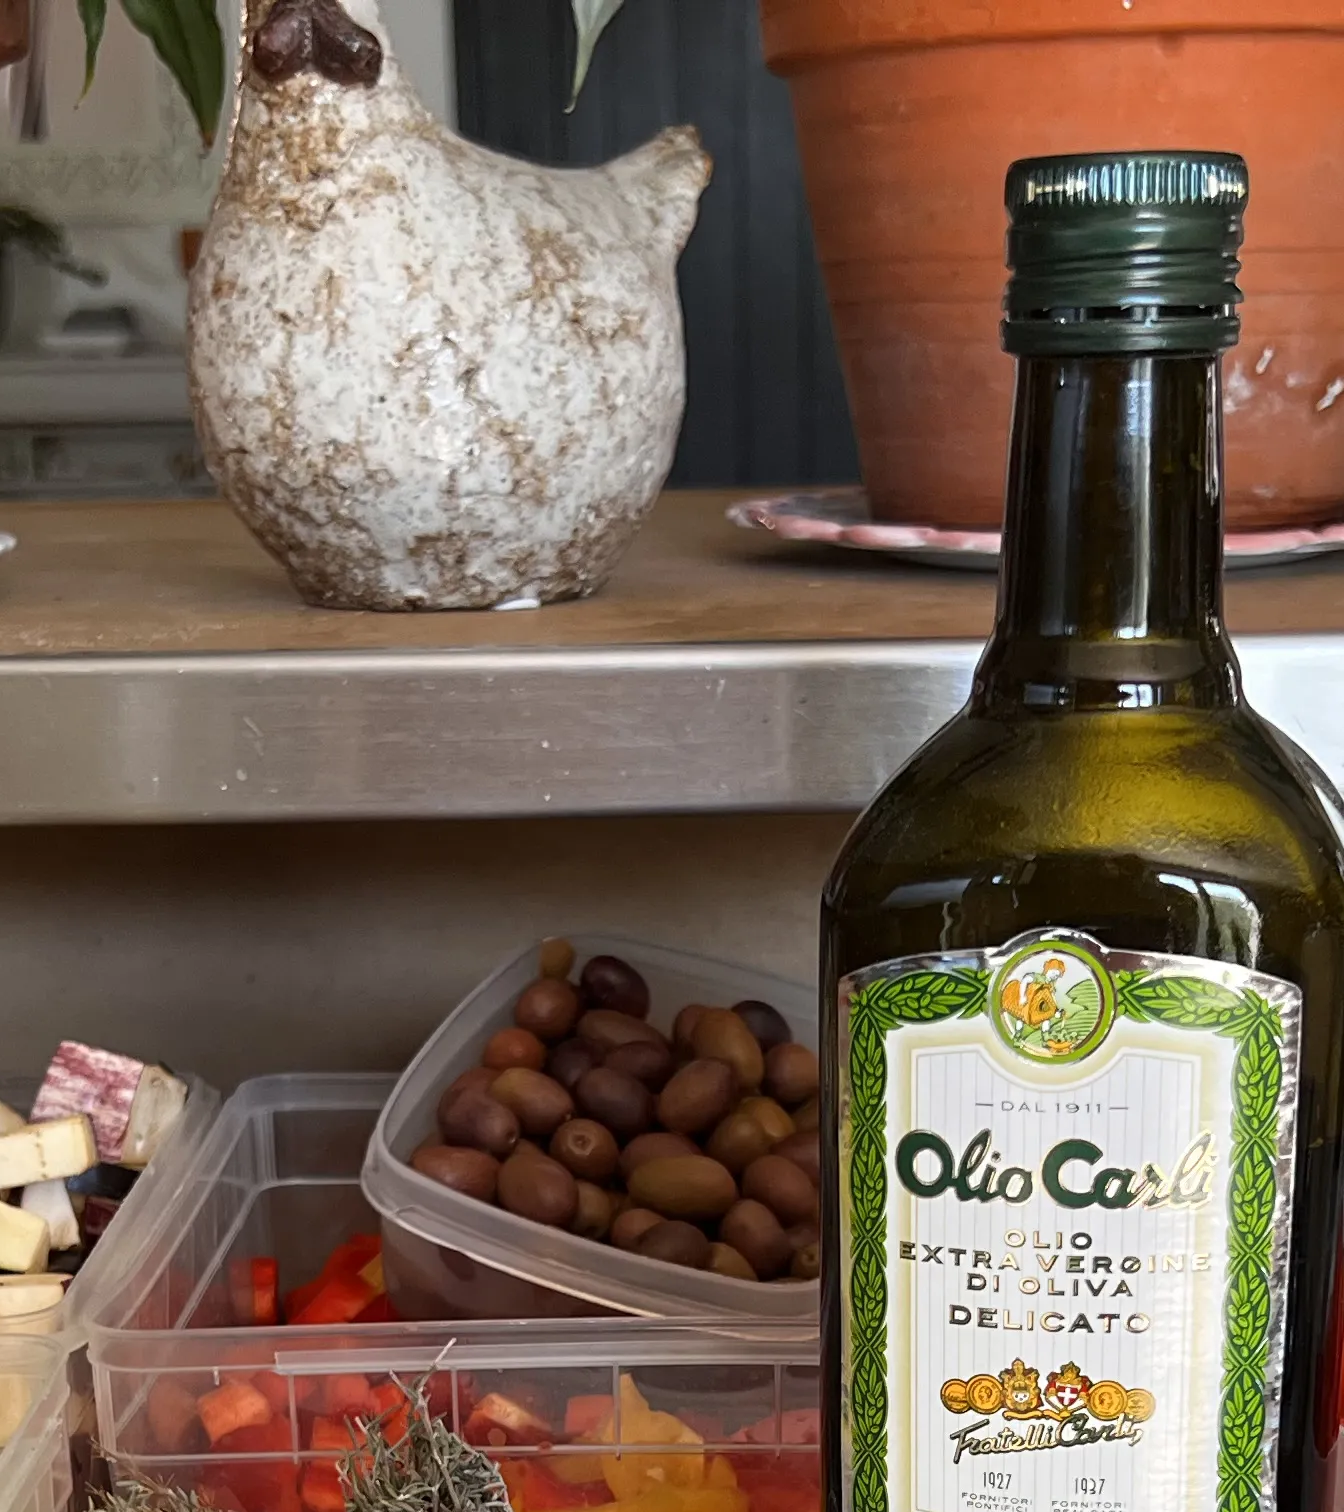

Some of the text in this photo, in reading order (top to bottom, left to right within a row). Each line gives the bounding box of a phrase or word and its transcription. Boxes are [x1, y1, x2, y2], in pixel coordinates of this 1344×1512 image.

[1001, 1101, 1102, 1114] DAL 1911
[895, 1128, 1220, 1210] Olio Carli
[1003, 1229, 1092, 1250] OLIO
[899, 1240, 1020, 1271] EXTRA
[966, 1272, 1134, 1297] DI OLIVA
[948, 1304, 1152, 1334] DELICATO
[949, 1418, 1057, 1465] Fratelli
[983, 1471, 1012, 1490] 1927
[1074, 1477, 1106, 1495] 1937
[961, 1492, 1033, 1506] FORNITORI
[1051, 1500, 1127, 1509] FORNITORI
